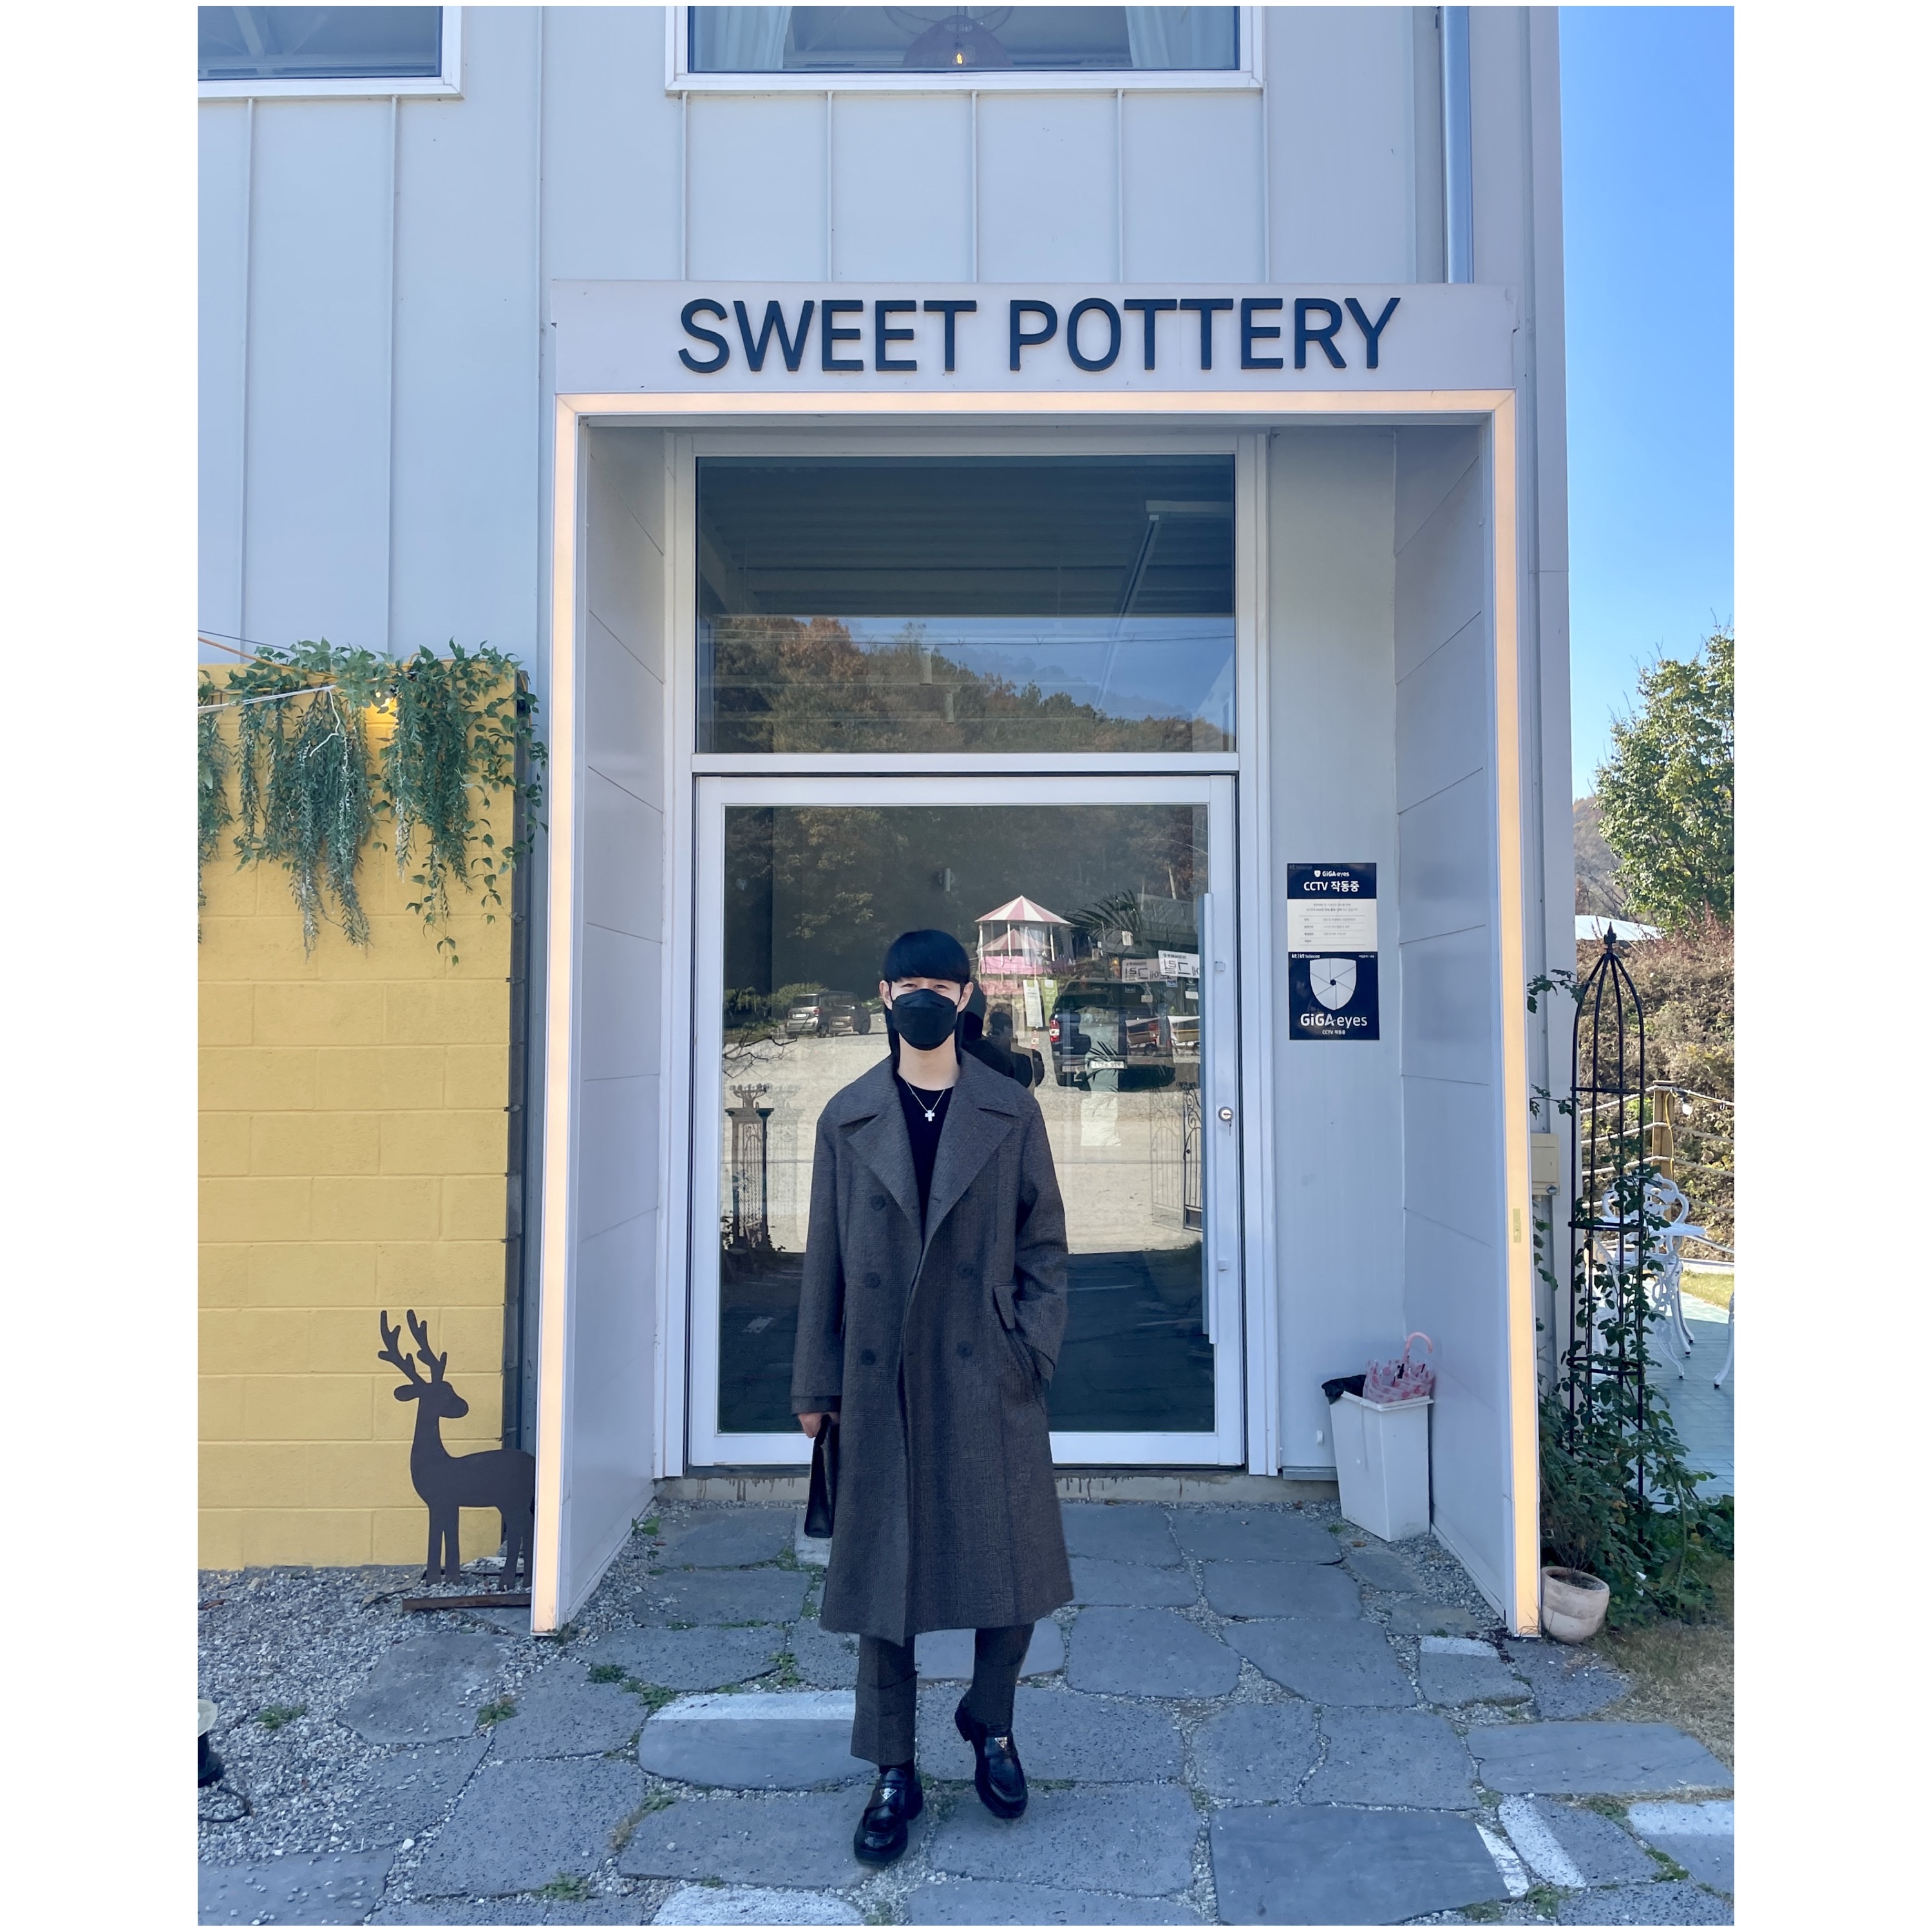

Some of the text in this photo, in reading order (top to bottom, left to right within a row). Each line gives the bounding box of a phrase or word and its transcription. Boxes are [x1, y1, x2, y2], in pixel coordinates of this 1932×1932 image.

[678, 297, 1401, 374] SWEET POTTERY
[1303, 880, 1360, 893] CCTV 작동중
